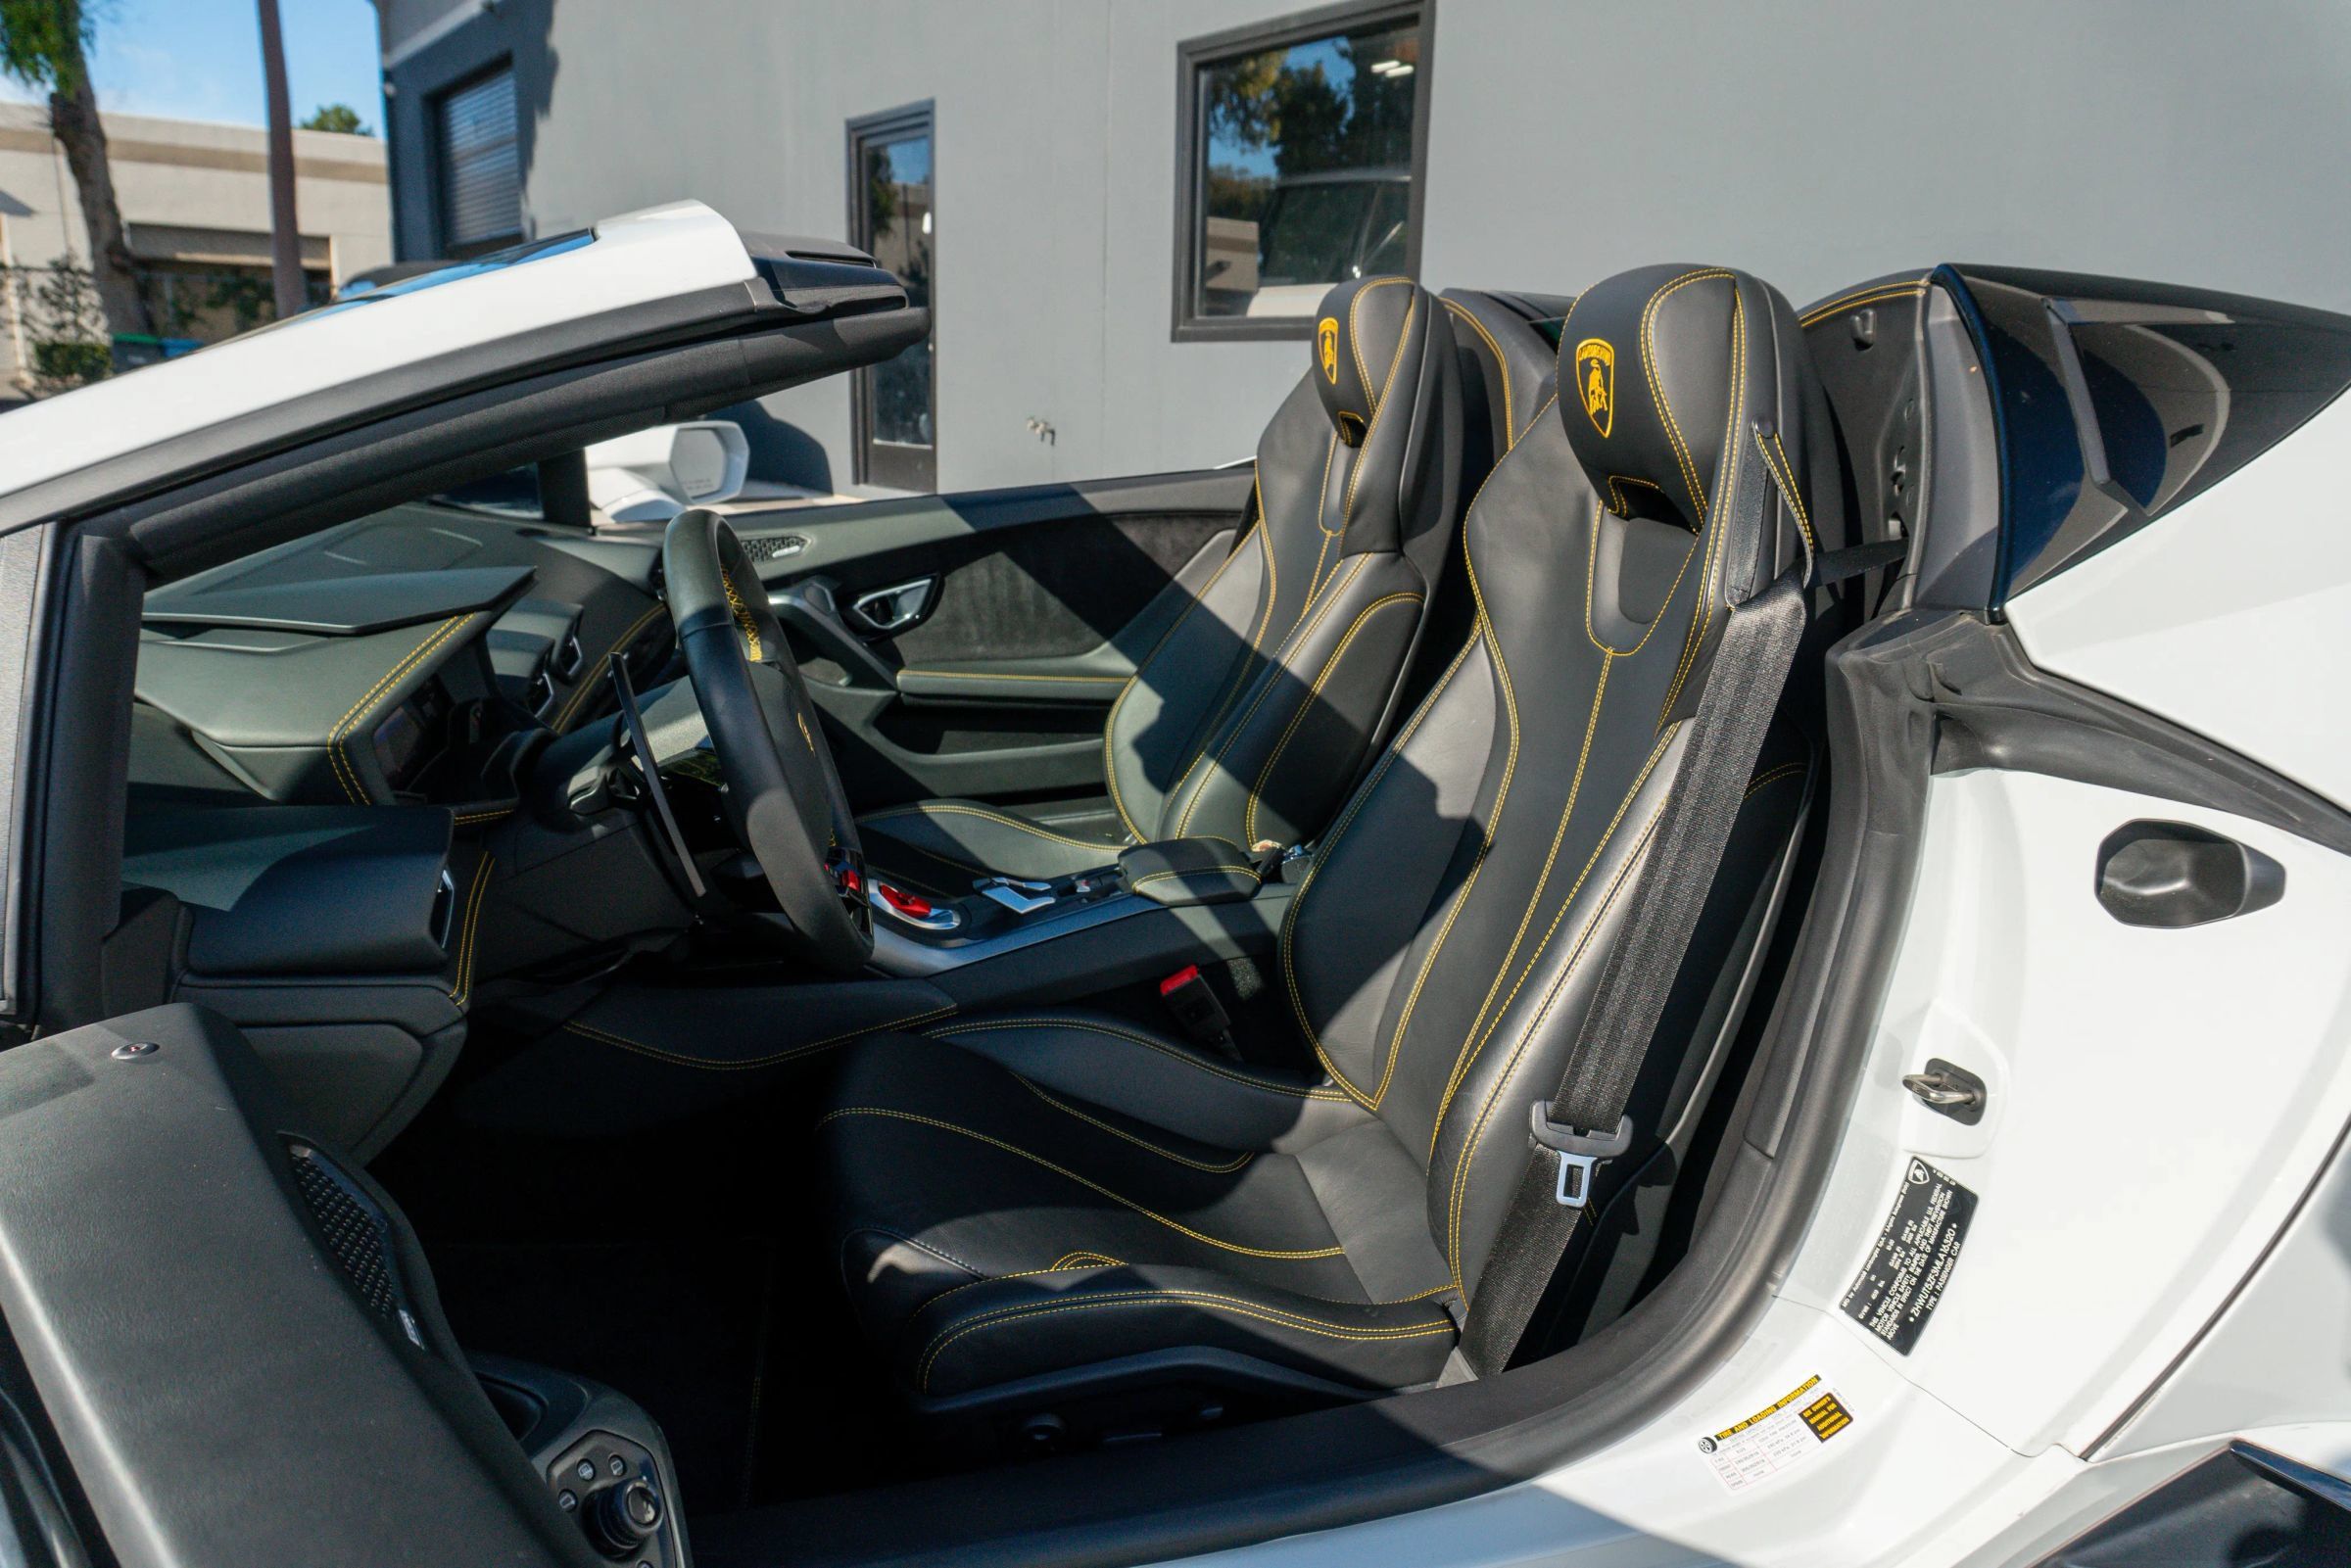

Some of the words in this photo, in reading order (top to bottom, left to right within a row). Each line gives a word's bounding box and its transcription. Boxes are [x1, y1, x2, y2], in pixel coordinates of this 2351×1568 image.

[1869, 1316, 1878, 1327] THIS
[1876, 1296, 1891, 1315] VEHICLE
[1889, 1266, 1907, 1296] CONFORMS
[1903, 1257, 1912, 1266] TO
[1908, 1247, 1917, 1257] ALL
[1914, 1216, 1929, 1245] APPLICABLE
[1931, 1183, 1942, 1205] FEDERAL
[1876, 1312, 1889, 1332] MOTOR
[1888, 1293, 1900, 1311] VEHICLE
[1918, 1238, 1927, 1250] AND
[1924, 1223, 1934, 1237] THEFT
[1931, 1192, 1945, 1222] PREVENTION
[1881, 1308, 1899, 1336] STANDARDS
[1900, 1286, 1912, 1303] EFFECT
[1909, 1276, 1918, 1286] ON
[1914, 1267, 1923, 1276] THE
[1919, 1254, 1928, 1266] DATE
[1925, 1244, 1932, 1254] OF
[1929, 1210, 1945, 1244] MANUFACTURE
[1943, 1190, 1952, 1209] SHOWN
[1926, 1296, 1937, 1310] TYPE
[1936, 1258, 1953, 1290] PASSENGER
[1951, 1241, 1960, 1256] CAR
[1887, 1323, 1898, 1340] ABOVE
[1719, 1429, 1732, 1440] TIRE
[1734, 1421, 1749, 1432] AND
[1749, 1405, 1776, 1424] LOADING
[1777, 1376, 1818, 1408] INFORMATION
[1809, 1408, 1828, 1424] MANUAL
[1827, 1402, 1836, 1411] FOR
[1817, 1410, 1842, 1430] ADDITIONAL
[1820, 1416, 1848, 1439] INFORMATION
